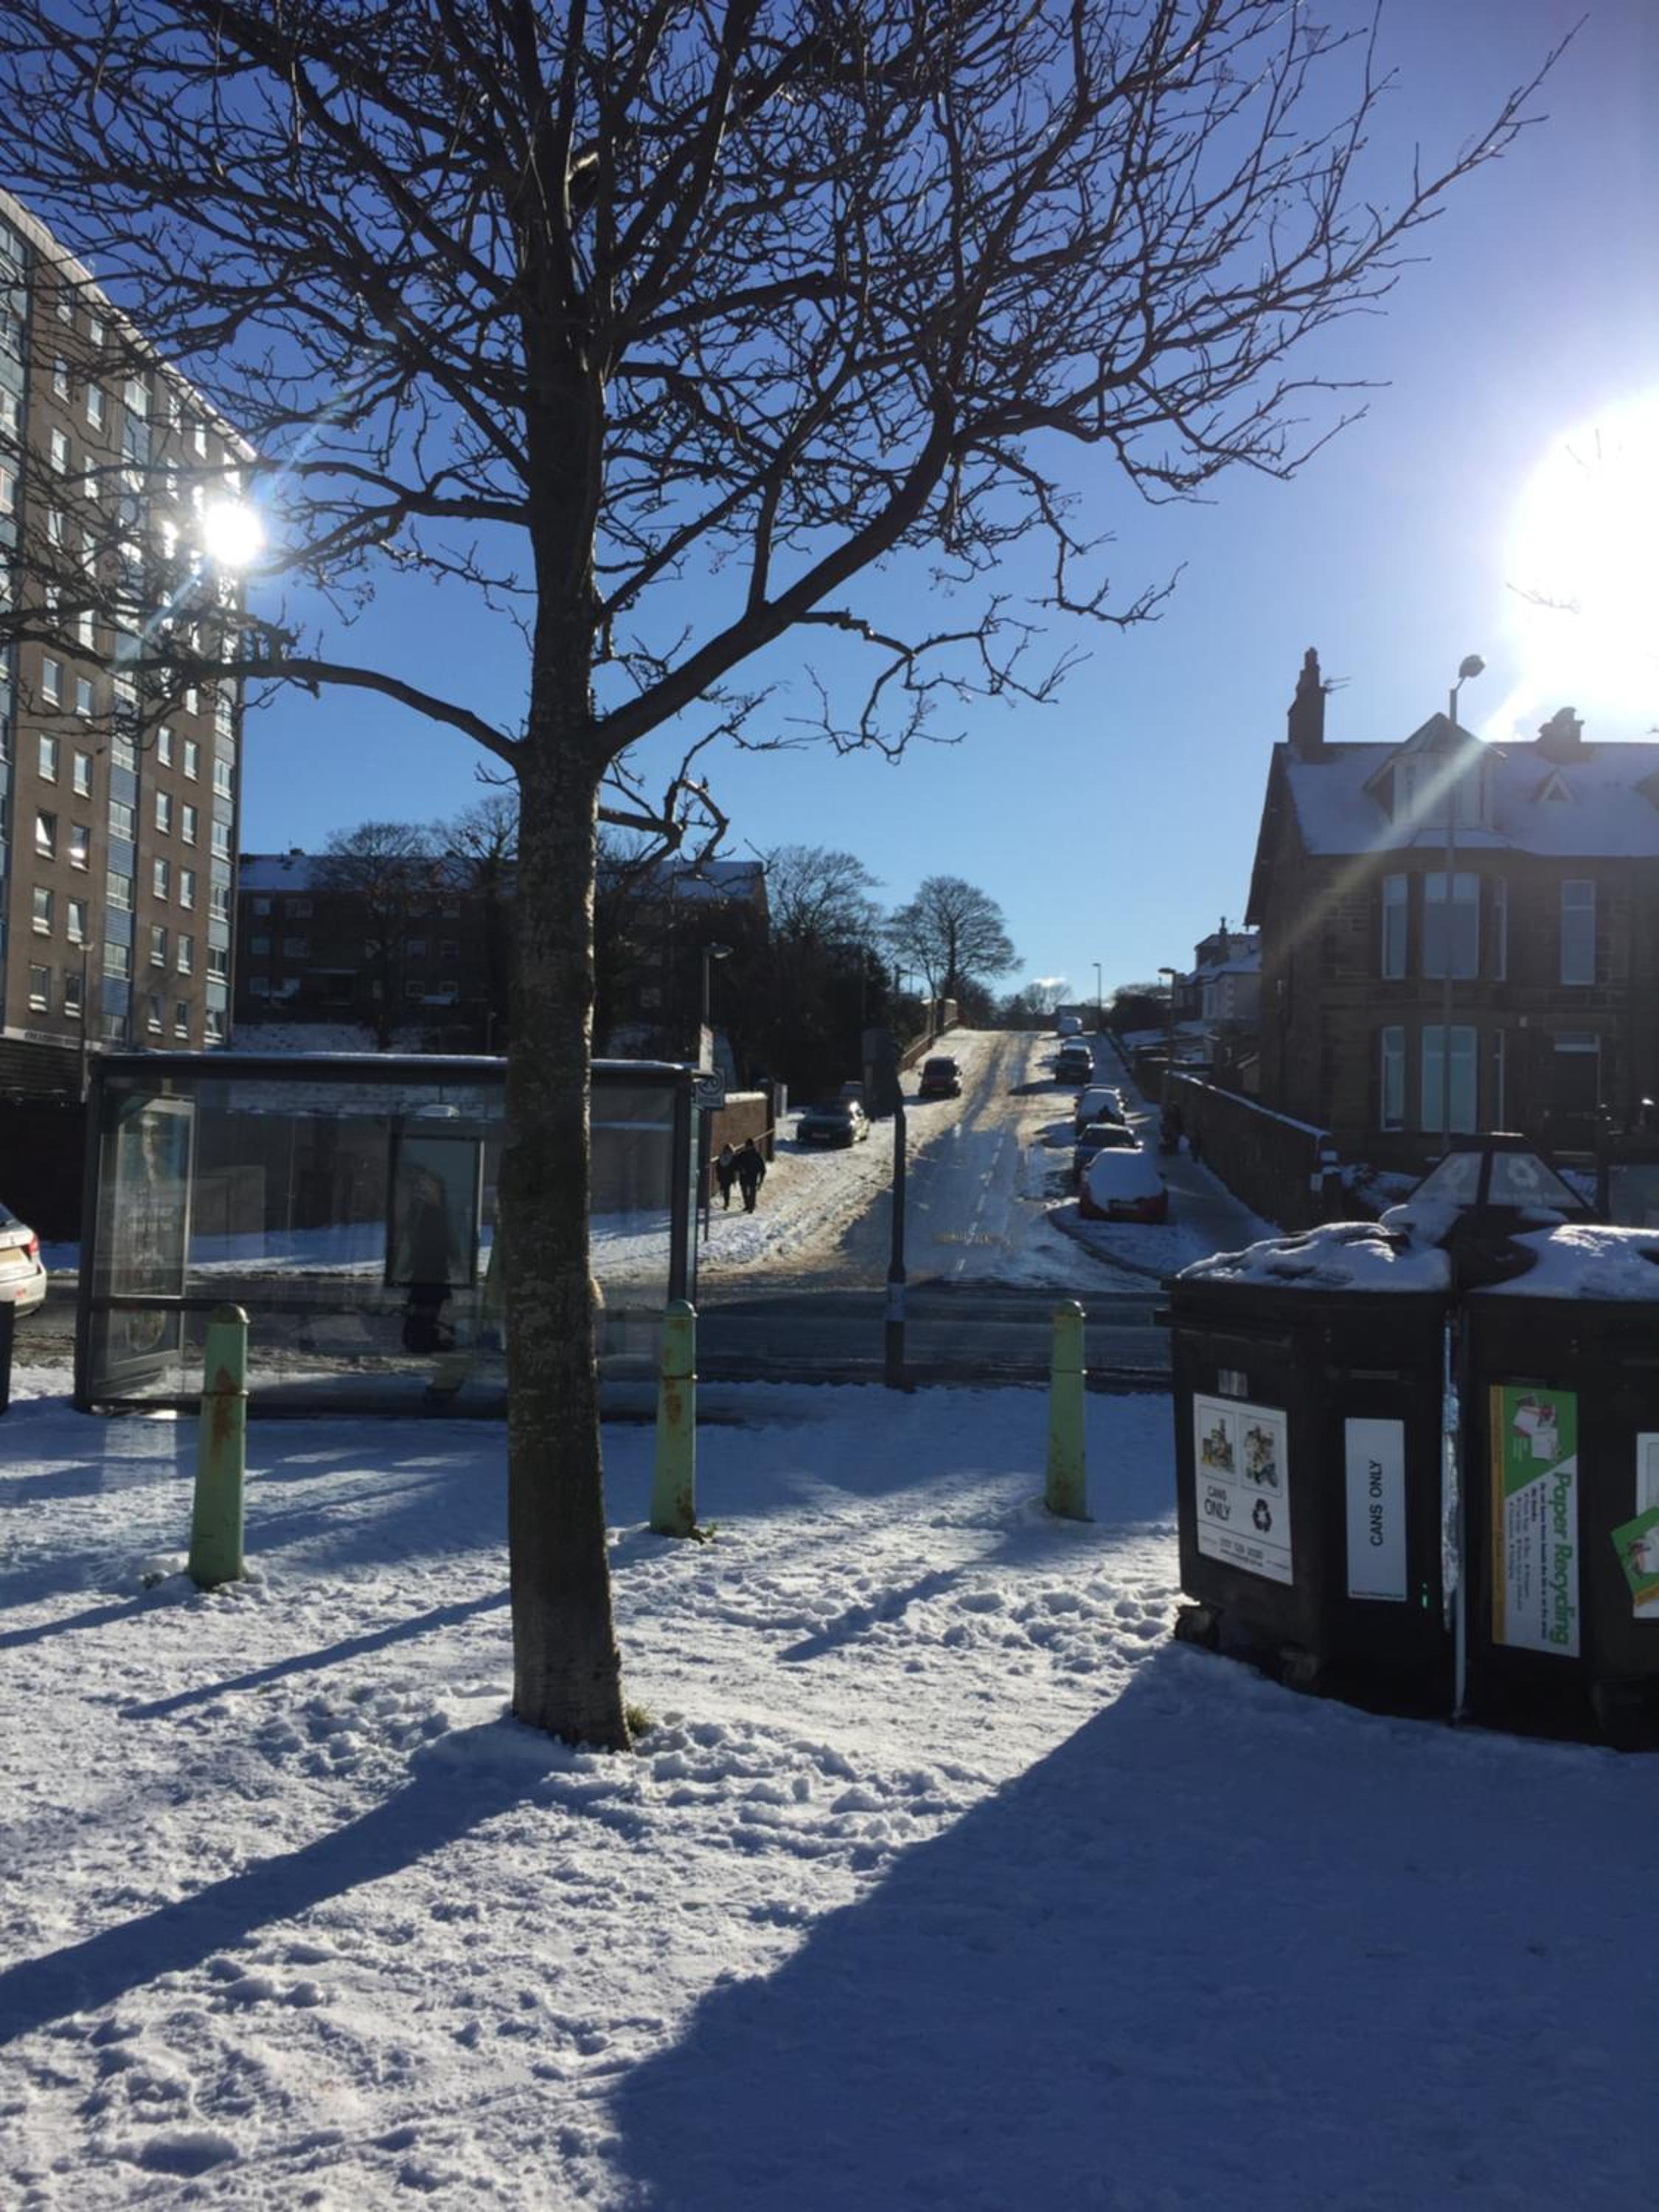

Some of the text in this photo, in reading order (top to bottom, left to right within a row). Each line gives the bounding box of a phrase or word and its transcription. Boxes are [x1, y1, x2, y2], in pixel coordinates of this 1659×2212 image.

[1204, 1498, 1231, 1521] ONLY
[1207, 1485, 1227, 1501] CANS
[1369, 1460, 1383, 1546] CANS ONLY
[1549, 1473, 1575, 1646] Paper Recycling
